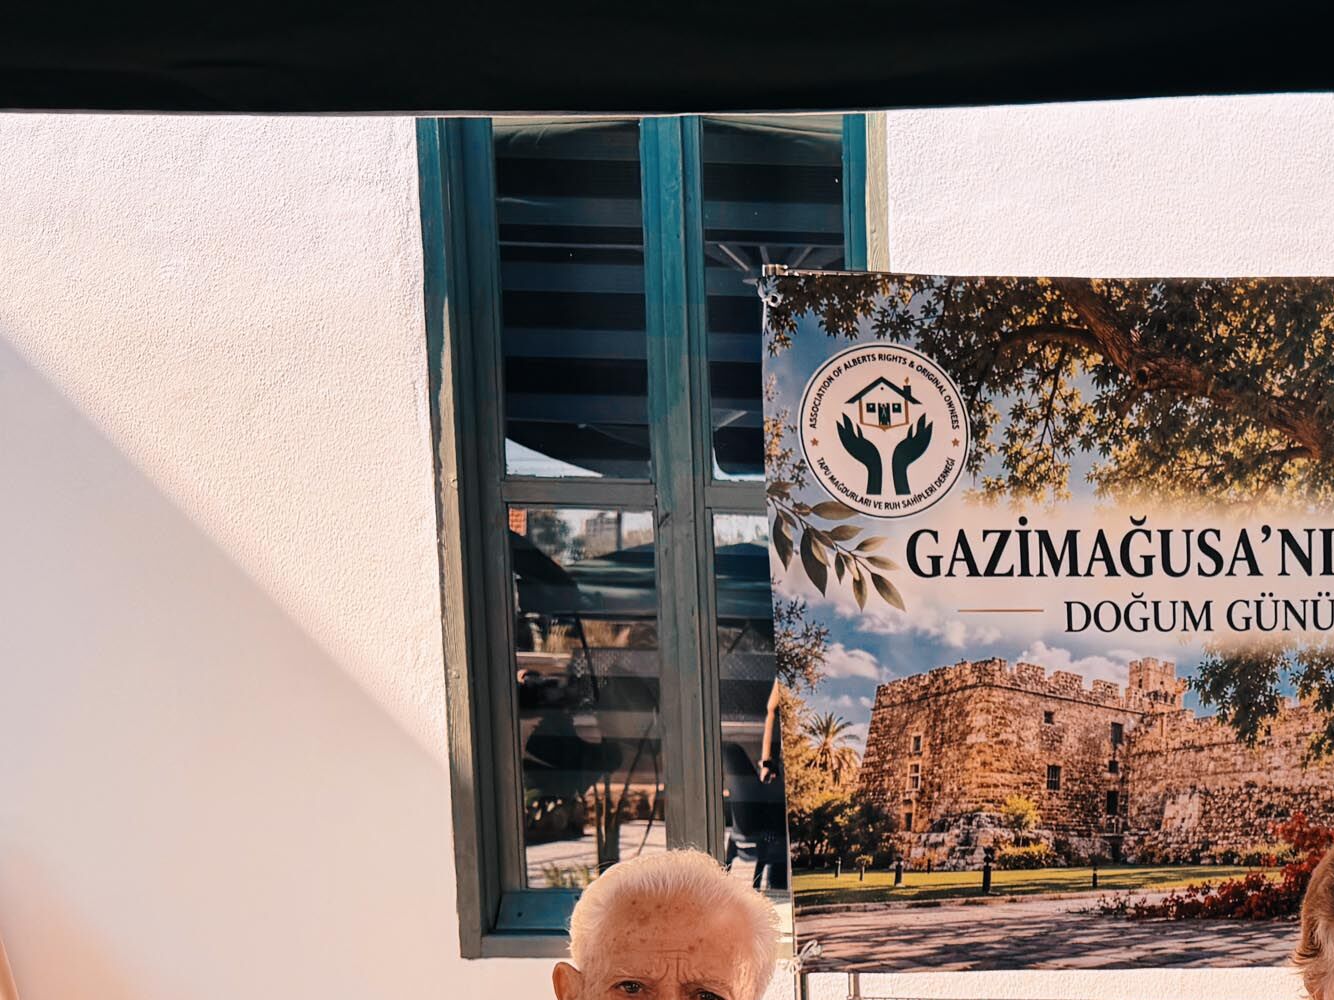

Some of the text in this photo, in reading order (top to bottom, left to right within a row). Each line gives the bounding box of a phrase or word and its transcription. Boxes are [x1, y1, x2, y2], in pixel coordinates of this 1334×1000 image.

[809, 375, 835, 429] ASSOCIATION
[832, 367, 843, 378] OF
[843, 353, 876, 371] ALBERTS
[878, 353, 907, 365] RIGHTS
[908, 360, 915, 369] &
[916, 365, 947, 396] ORIGINAL
[816, 457, 831, 476] TAPU
[873, 502, 883, 510] VE
[884, 502, 901, 511] RUH
[1064, 592, 1215, 633] DOĞUM
